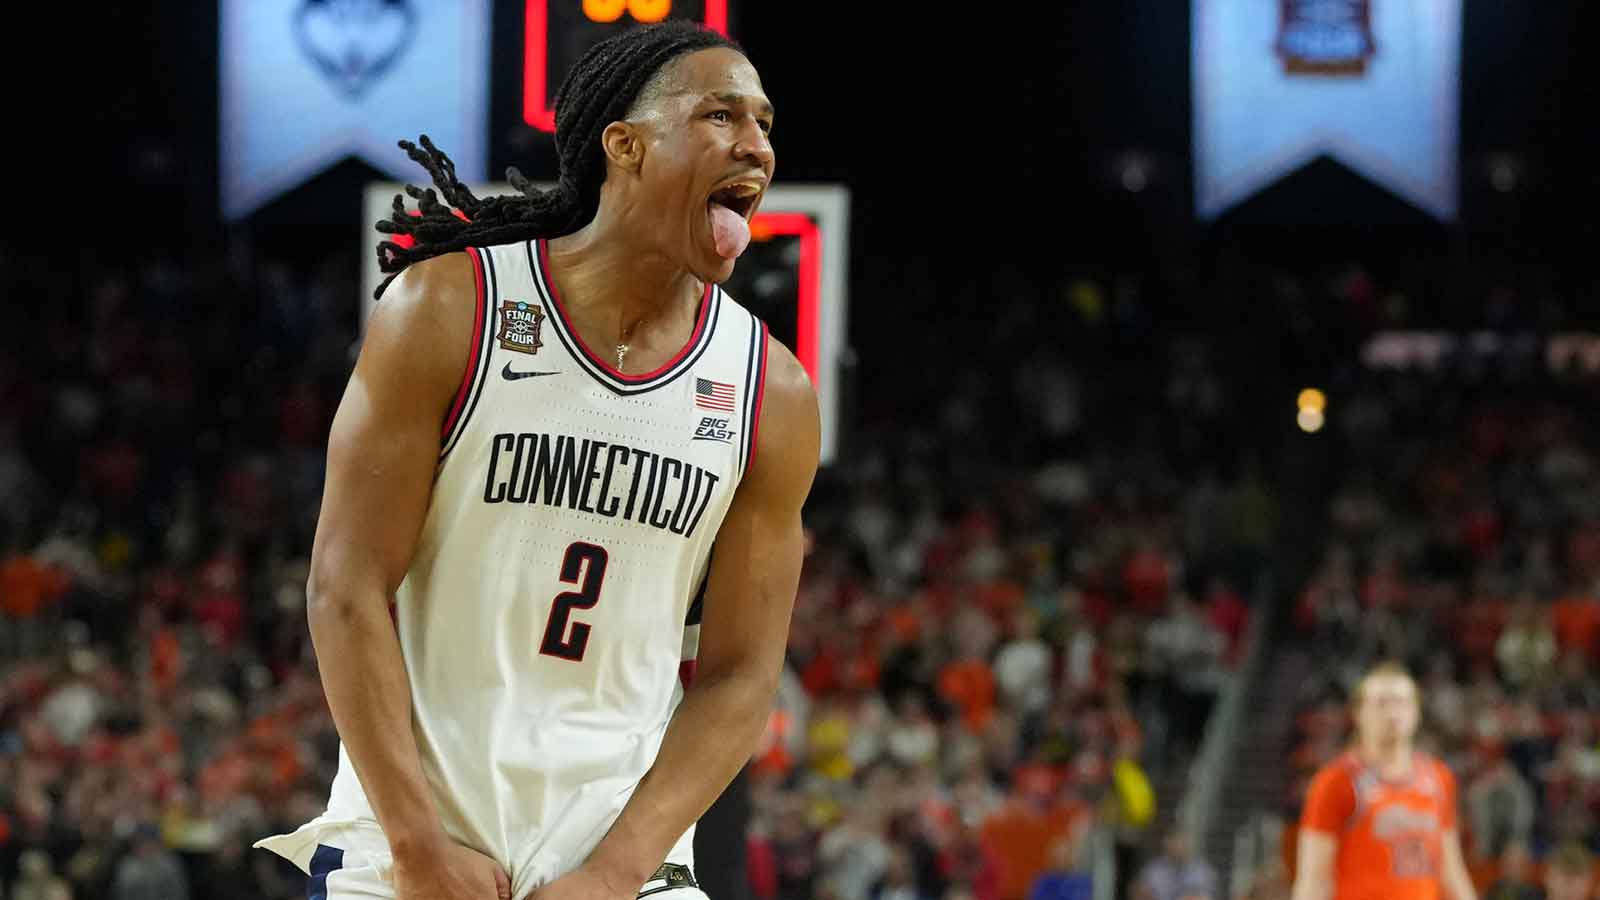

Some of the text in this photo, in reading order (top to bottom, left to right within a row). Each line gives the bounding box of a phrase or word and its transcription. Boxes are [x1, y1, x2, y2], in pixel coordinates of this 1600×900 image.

[506, 310, 537, 324] FINAL
[505, 330, 534, 345] FOUR
[700, 417, 729, 429] BIG
[695, 426, 736, 440] EAST
[483, 432, 720, 539] CONNECTICUT
[539, 541, 609, 662] 2
